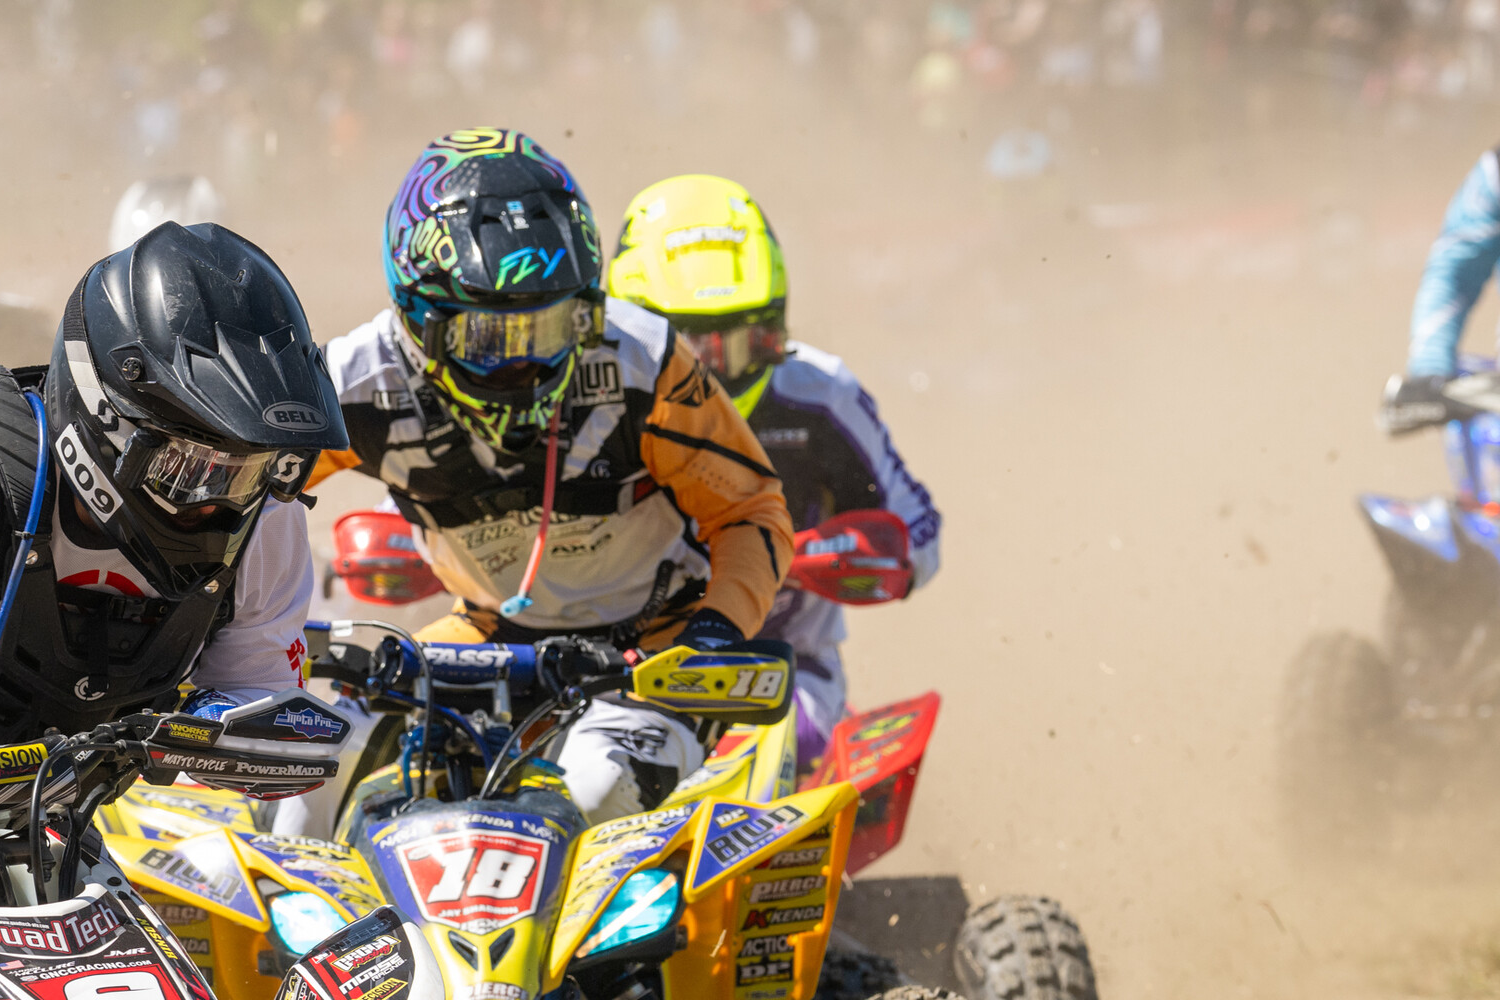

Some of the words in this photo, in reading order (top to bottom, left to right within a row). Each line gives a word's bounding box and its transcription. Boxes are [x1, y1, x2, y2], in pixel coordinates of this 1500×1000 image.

[495, 246, 567, 290] FLY
[273, 410, 321, 426] BELL
[60, 436, 115, 514] 009
[423, 647, 514, 668] FASST
[727, 670, 785, 699] 18
[170, 723, 211, 735] WORKS
[171, 731, 209, 742] CONNECTION
[162, 753, 195, 767] MATTO
[195, 759, 228, 771] CYCLE
[461, 814, 515, 830] KENDA
[716, 809, 747, 827] DP
[251, 835, 342, 852] ACTION
[772, 848, 826, 865] FASST
[426, 848, 537, 904] 18
[751, 875, 826, 904] PIERCE
[770, 906, 825, 925] KENDA
[64, 903, 122, 950] Tech
[136, 917, 179, 960] HINSON
[743, 936, 795, 958] ACTIO
[105, 947, 147, 957] JMR
[39, 959, 153, 980] GNCCRACING.COM
[338, 952, 405, 996] MOOSE
[372, 959, 407, 982] RACING
